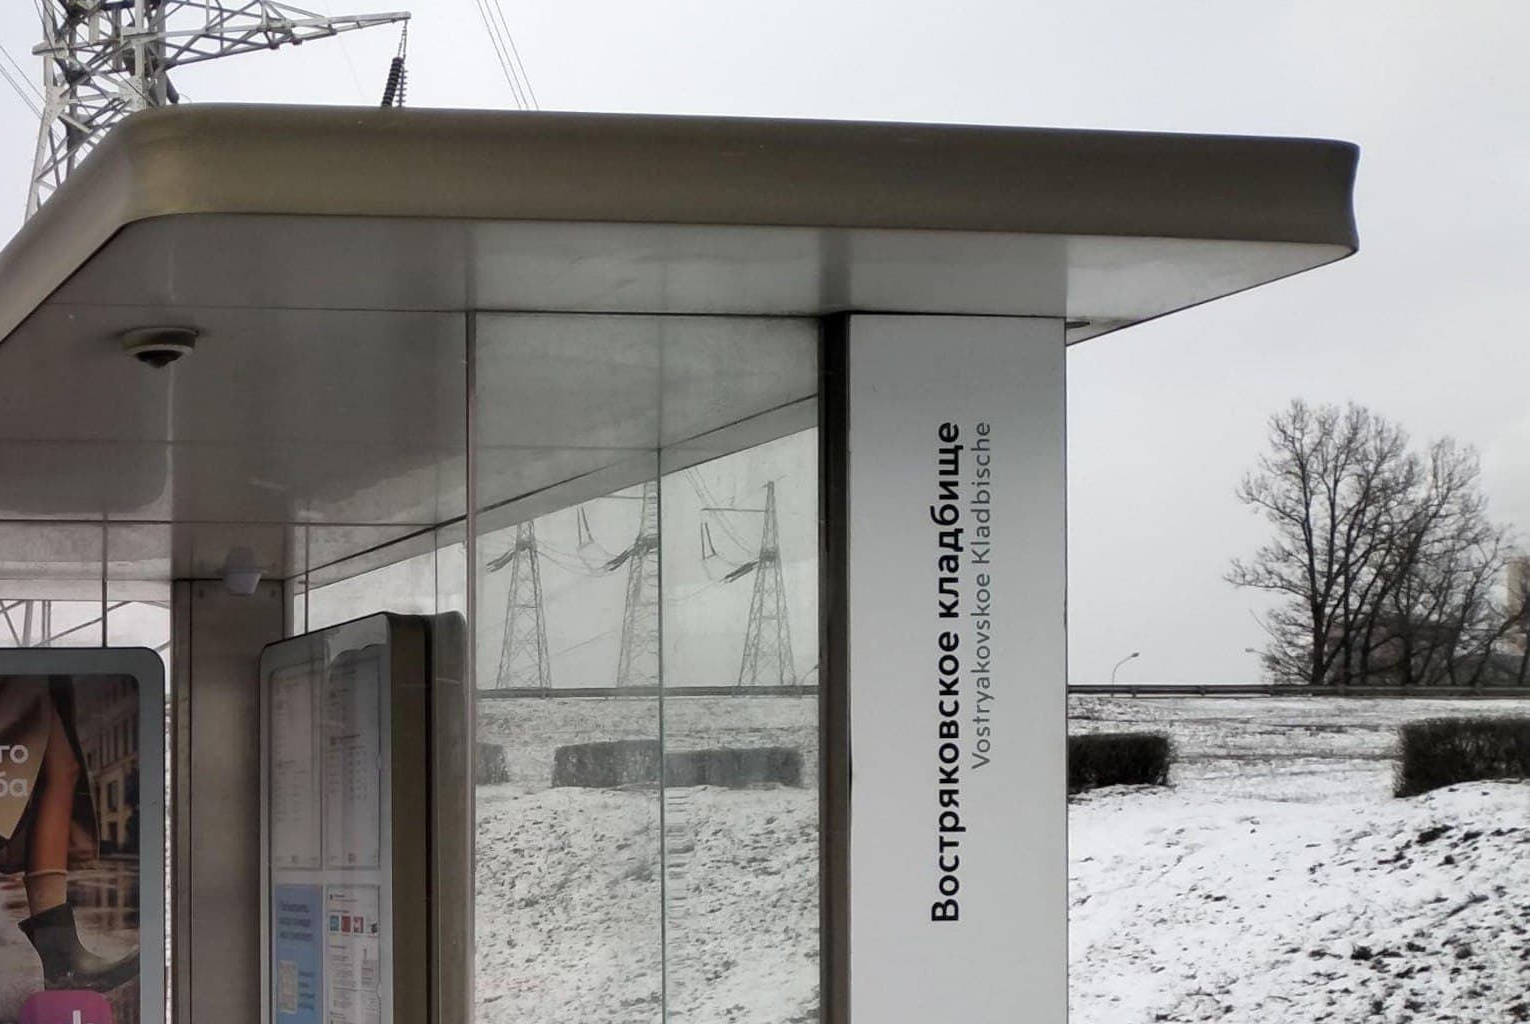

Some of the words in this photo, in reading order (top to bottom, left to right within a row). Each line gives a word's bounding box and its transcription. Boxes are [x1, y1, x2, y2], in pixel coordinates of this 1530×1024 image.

[930, 421, 964, 618] кладбище
[970, 421, 991, 564] Kladbische
[970, 573, 995, 770] Vostryakovskoe
[931, 631, 966, 921] Востряковское
